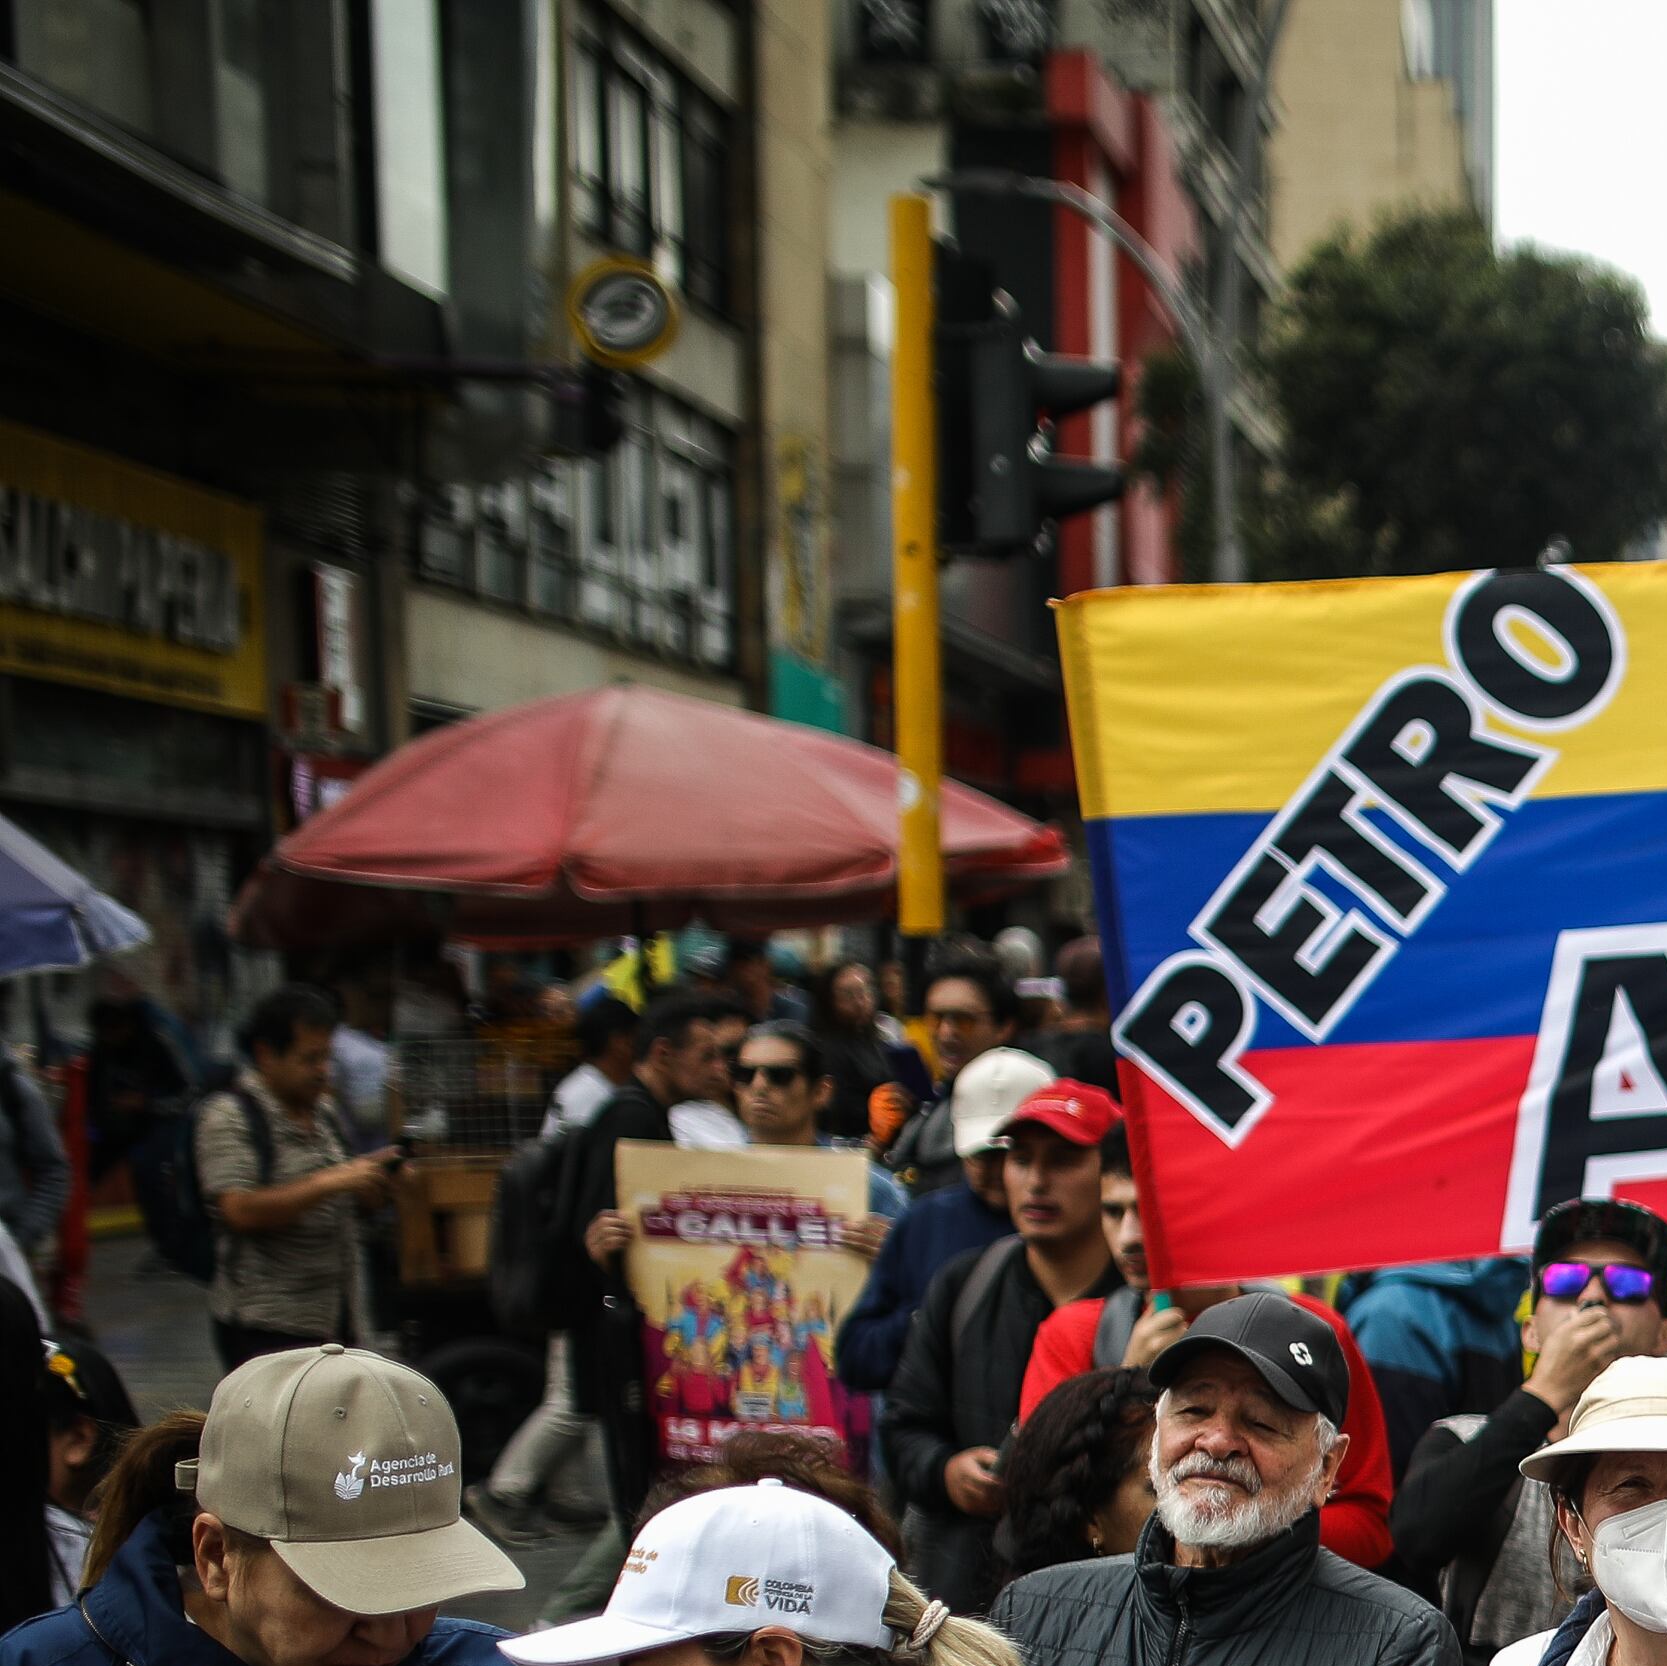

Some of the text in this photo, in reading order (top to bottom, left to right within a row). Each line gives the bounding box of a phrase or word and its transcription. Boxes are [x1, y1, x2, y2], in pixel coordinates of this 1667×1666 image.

[1111, 563, 1627, 1150] PETRO
[370, 1455, 424, 1474] Agencia
[370, 1469, 436, 1488] Desarrollo
[765, 1580, 813, 1594] COLOMBIA
[766, 1595, 811, 1615] VIDA
